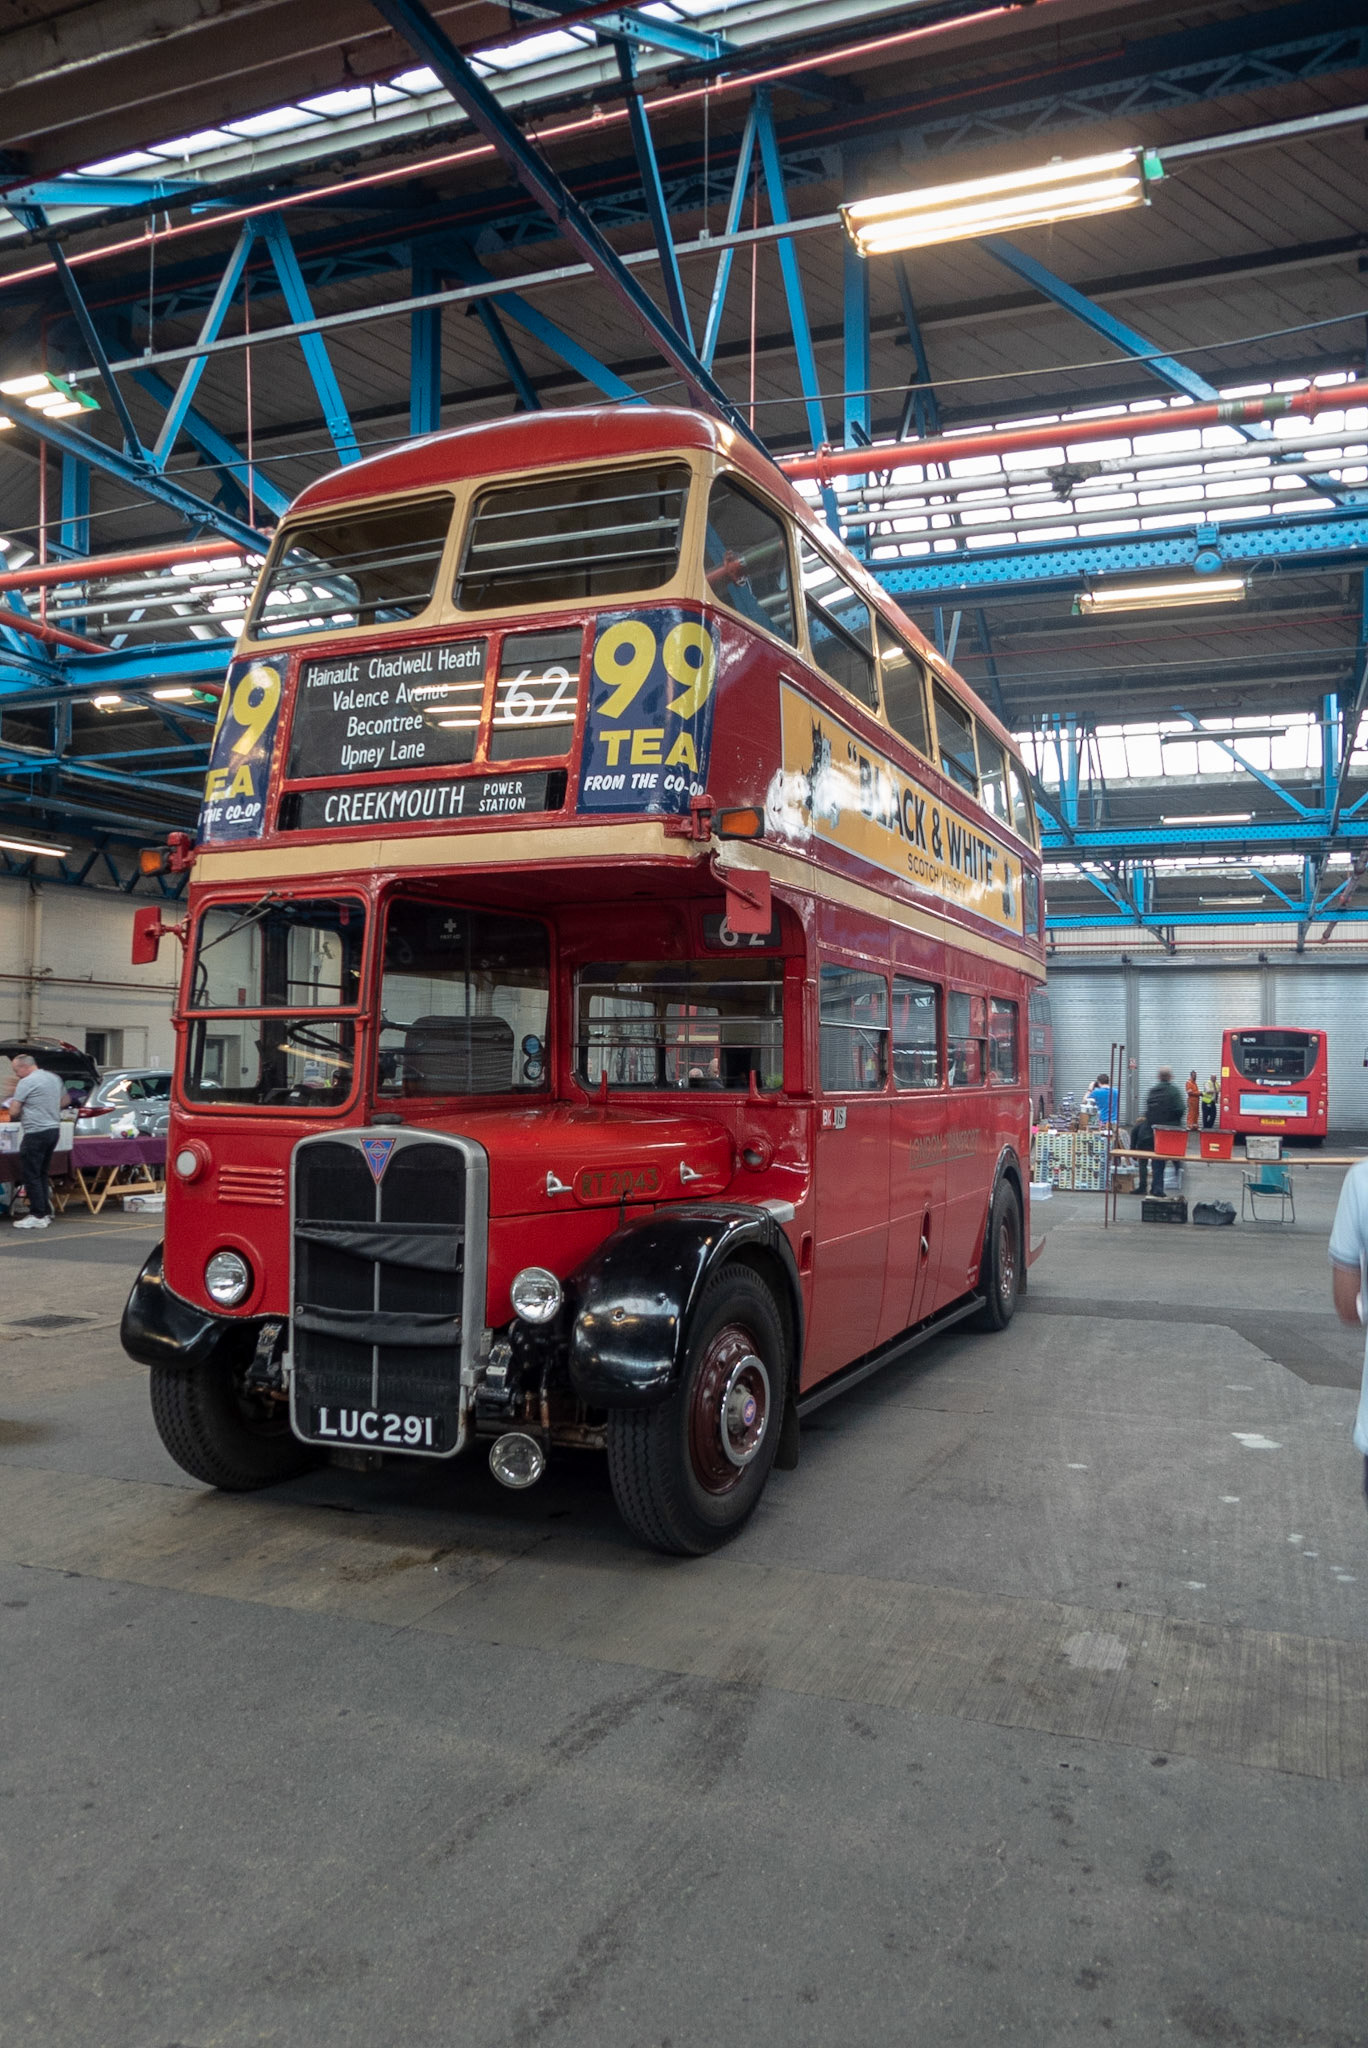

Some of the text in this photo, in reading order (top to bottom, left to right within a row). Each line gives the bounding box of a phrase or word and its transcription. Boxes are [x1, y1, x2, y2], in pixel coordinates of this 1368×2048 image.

[307, 646, 481, 688] Hainault Chadwell Heath
[593, 620, 715, 720] 99
[211, 666, 281, 756] 9
[333, 683, 449, 712] Valence Avenue
[503, 666, 569, 724] 62
[347, 714, 423, 738] Becontree
[341, 740, 425, 770] Upney Lane
[599, 728, 698, 773] TEA
[205, 765, 255, 802] EA
[483, 782, 522, 796] POWER
[584, 774, 625, 791] FROM
[631, 773, 659, 789] THE
[203, 808, 223, 824] THE
[226, 803, 261, 820] CO-OP
[324, 785, 465, 823] CREEKMOUTH
[479, 797, 526, 812] STATION
[932, 807, 944, 862] &
[907, 852, 939, 885] SCOTCH
[582, 1168, 659, 1197] RT 2043
[319, 1407, 432, 1446] LUC291
